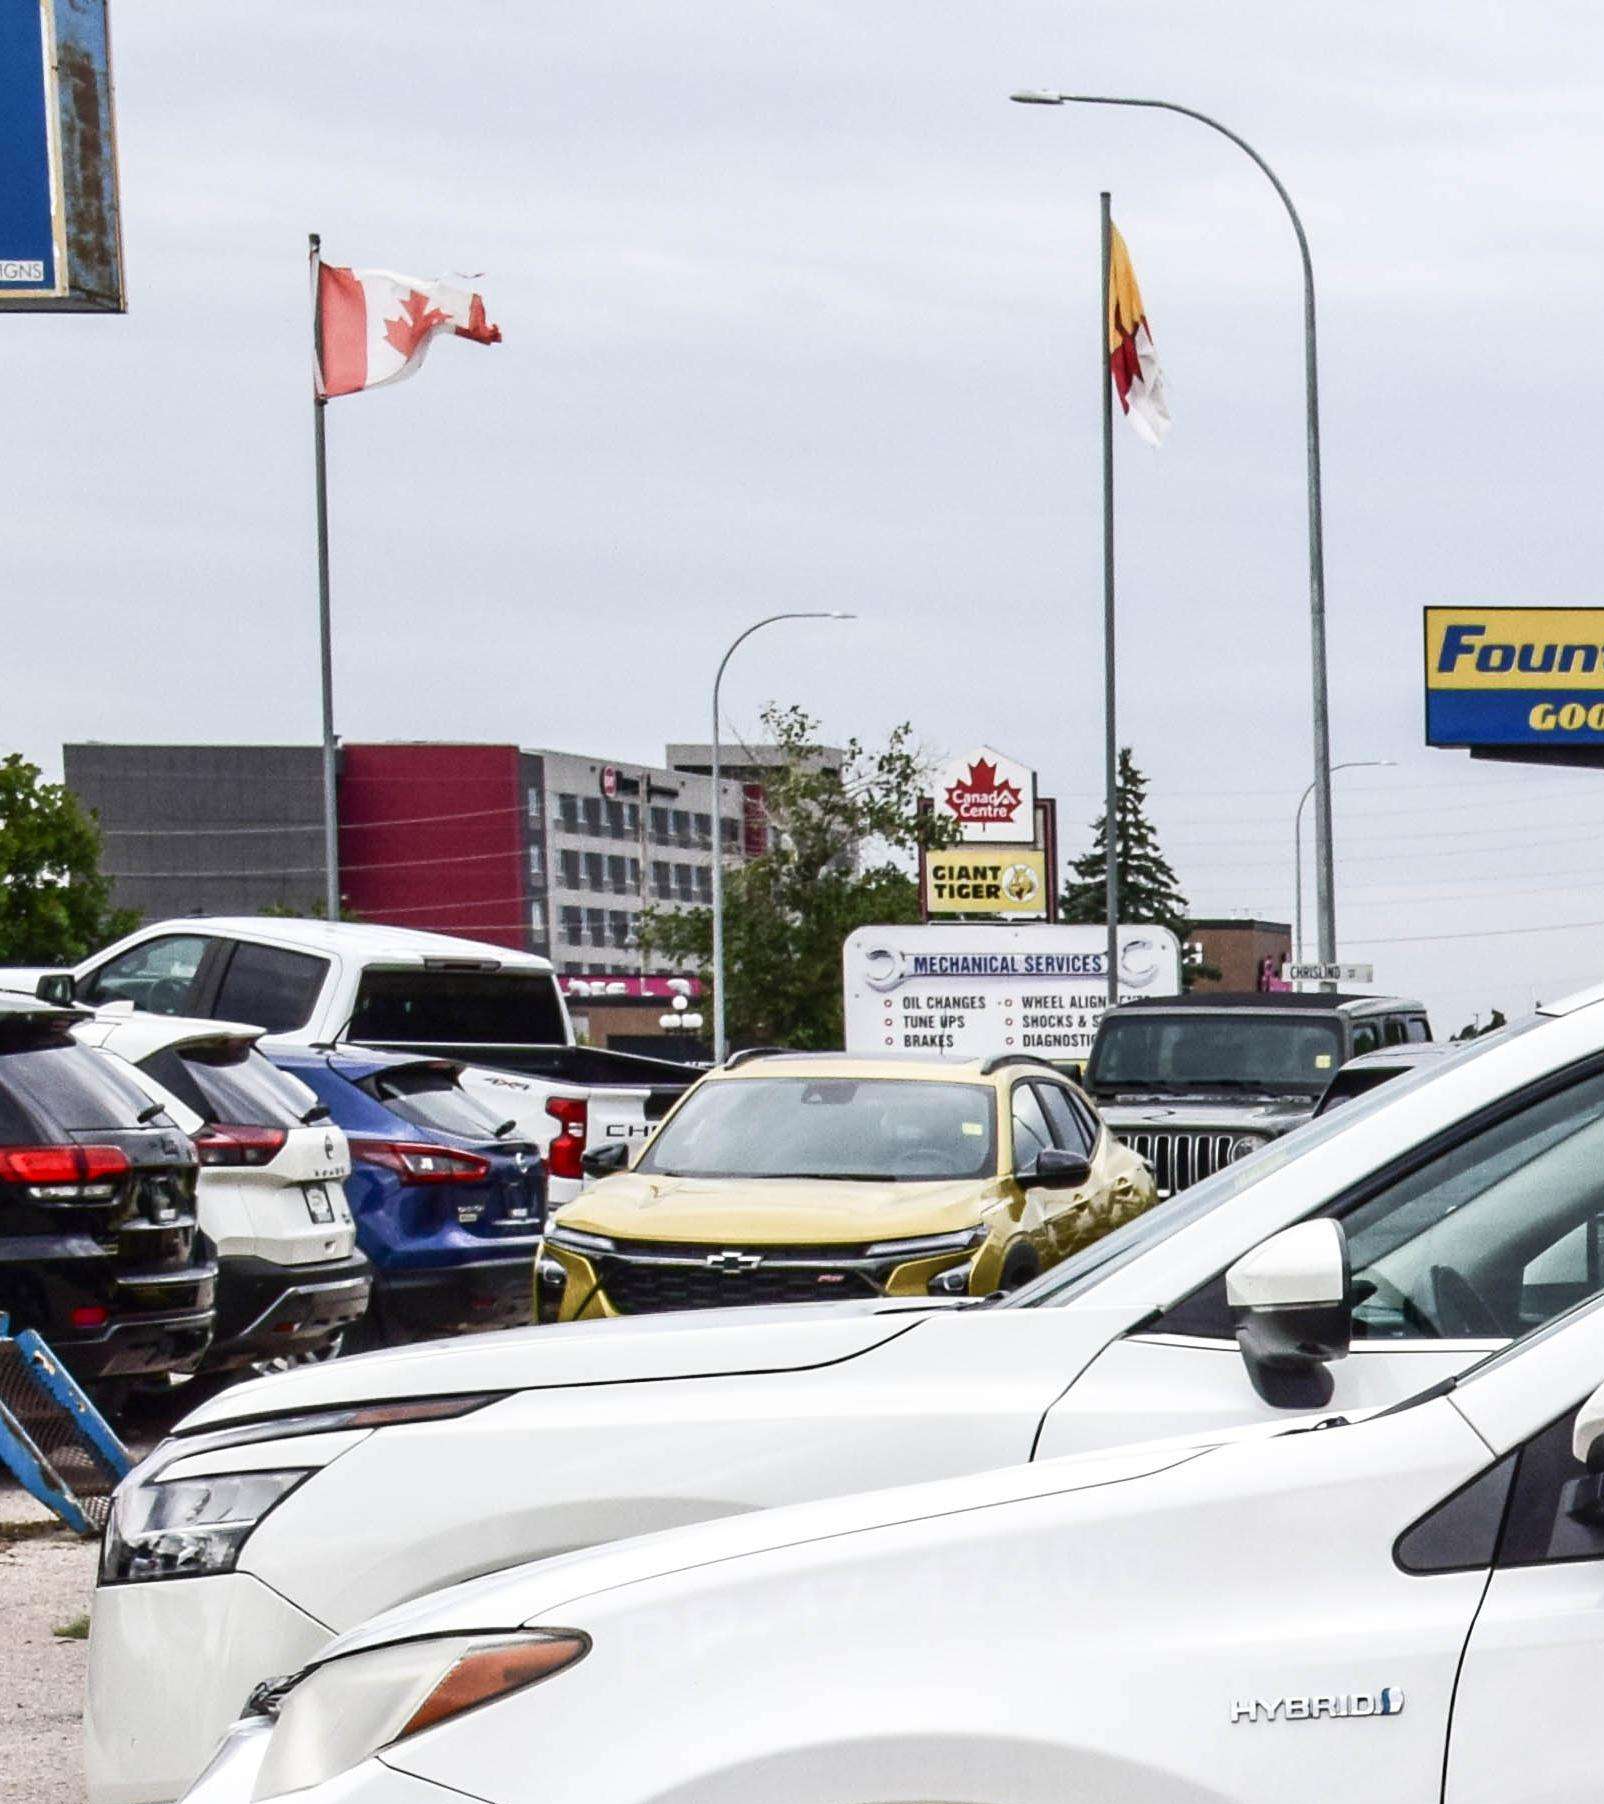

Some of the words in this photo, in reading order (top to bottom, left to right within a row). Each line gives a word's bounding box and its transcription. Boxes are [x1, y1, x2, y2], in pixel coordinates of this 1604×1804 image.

[960, 803, 1008, 818] Centre
[932, 865, 1002, 881] GIANT
[934, 883, 1001, 899] TIGER
[914, 956, 1018, 974] MECHANICAL
[1024, 955, 1102, 973] SERVICES
[902, 996, 922, 1010] OIL
[926, 996, 986, 1009] CHANGES
[1022, 995, 1068, 1009] WHEEL
[903, 1015, 935, 1029] TUNE
[940, 1015, 965, 1029] UPS
[1022, 1015, 1073, 1029] SHOCKS
[1078, 1015, 1087, 1028] &
[903, 1034, 954, 1048] BRAKES
[1230, 1695, 1377, 1723] HYBRID
